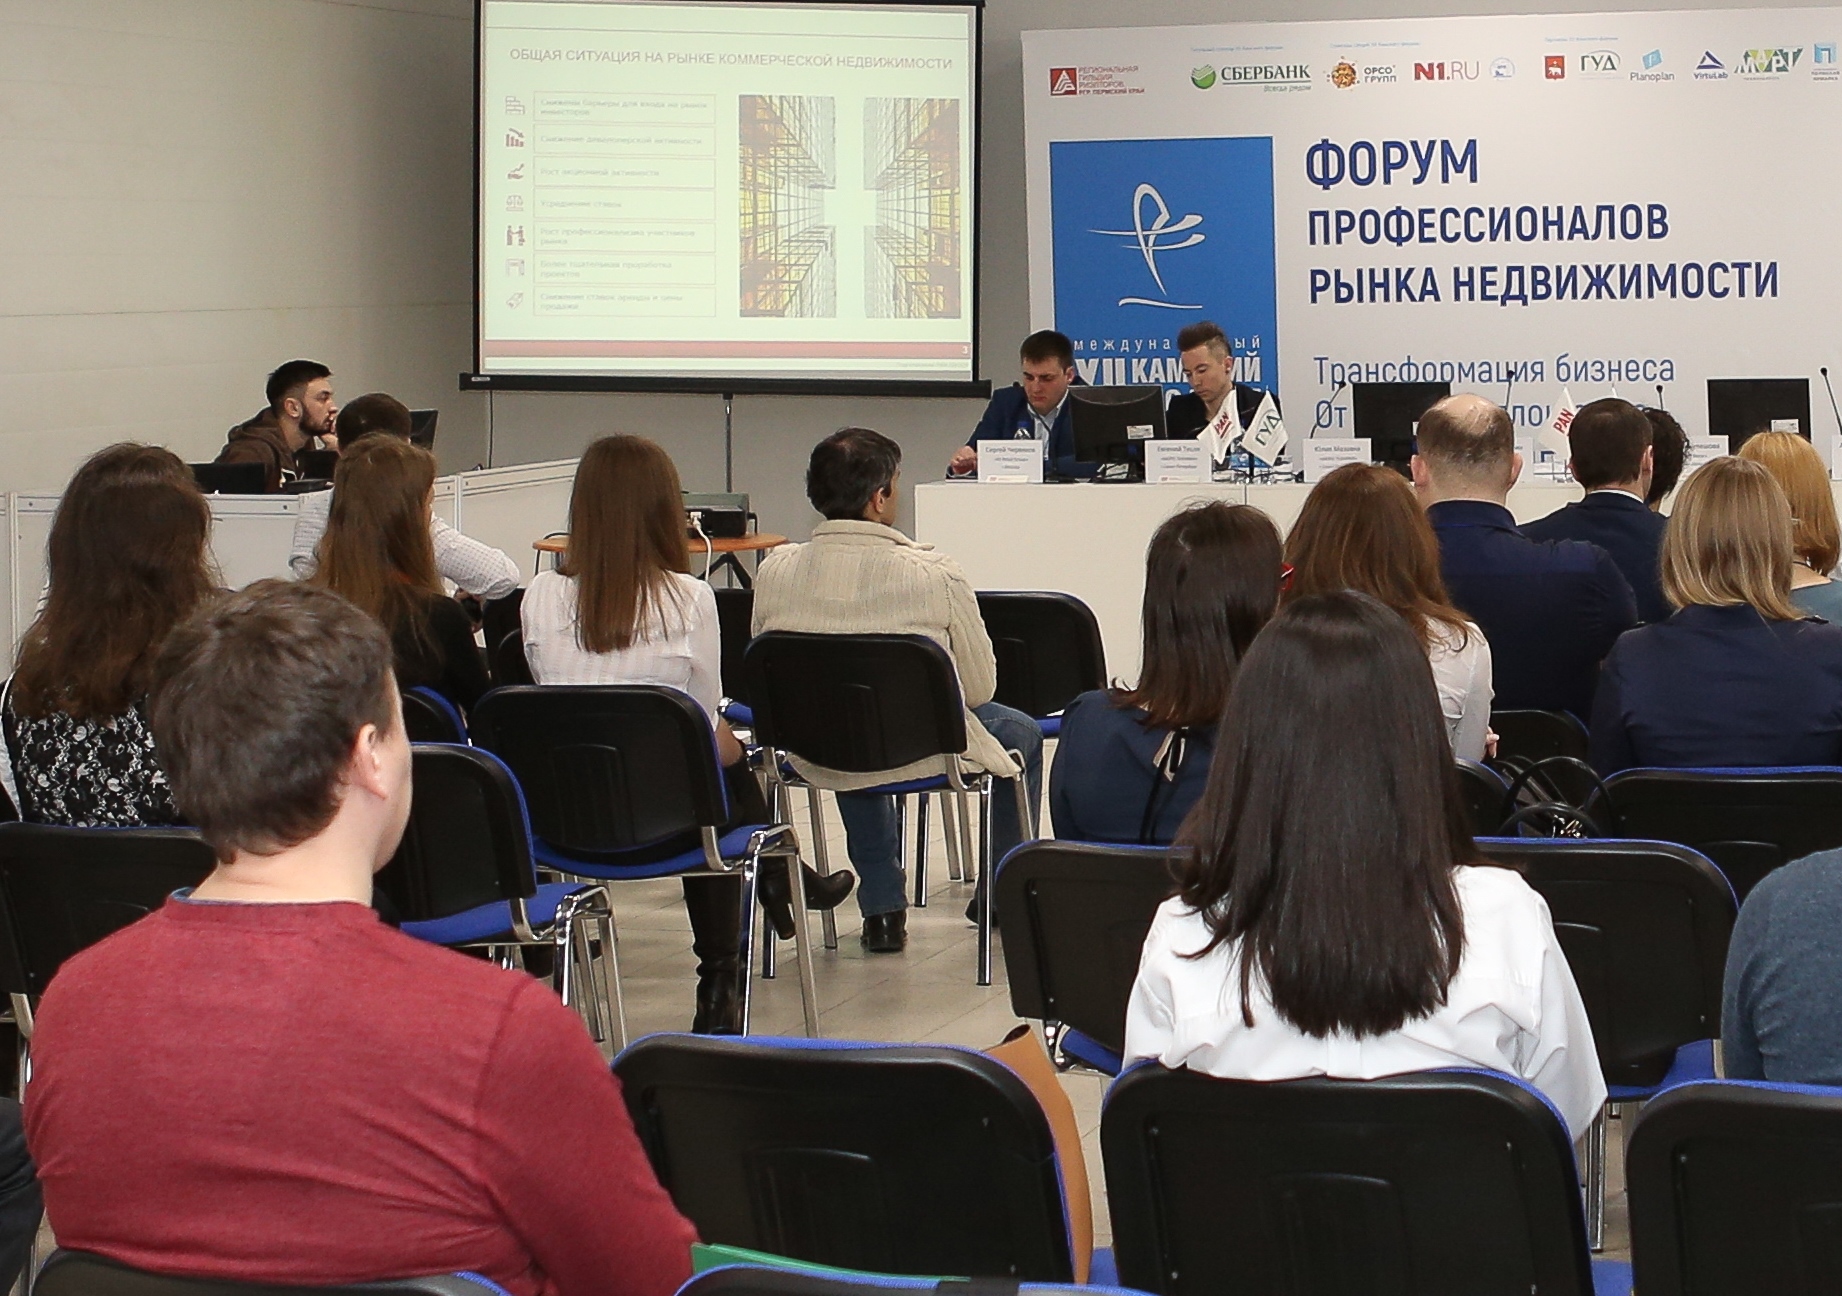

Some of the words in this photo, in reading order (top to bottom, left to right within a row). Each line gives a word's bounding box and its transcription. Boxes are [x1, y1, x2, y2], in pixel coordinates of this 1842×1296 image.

[510, 48, 562, 63] ОБЩАЯ
[565, 49, 641, 65] СИТУАЦИЯ
[644, 51, 664, 63] НА
[667, 52, 715, 64] РЫНКЕ
[719, 53, 833, 67] КОММЕРЧЕСКОЙ
[836, 56, 953, 69] НЕДВИЖИМОСТИ
[1414, 60, 1480, 80] N1.RU
[1580, 54, 1618, 71] ГУД
[1221, 64, 1311, 81] СБЕРБАНК
[1364, 75, 1397, 83] ГРУПП
[1630, 72, 1675, 83] Planoplan
[1306, 138, 1478, 190] ФОРУМ
[1308, 204, 1669, 247] ПРОФЕССИОНАЛОВ
[1309, 267, 1441, 304] РЫНКА
[1452, 261, 1778, 307] НЕДВИЖИМОСТИ
[1074, 334, 1261, 353] междунаый
[1132, 350, 1261, 384] КАМИЙ
[1313, 355, 1545, 391] Трансформация
[1556, 353, 1674, 383] бизнеса
[1316, 400, 1347, 429] От
[1553, 408, 1575, 435] PAN
